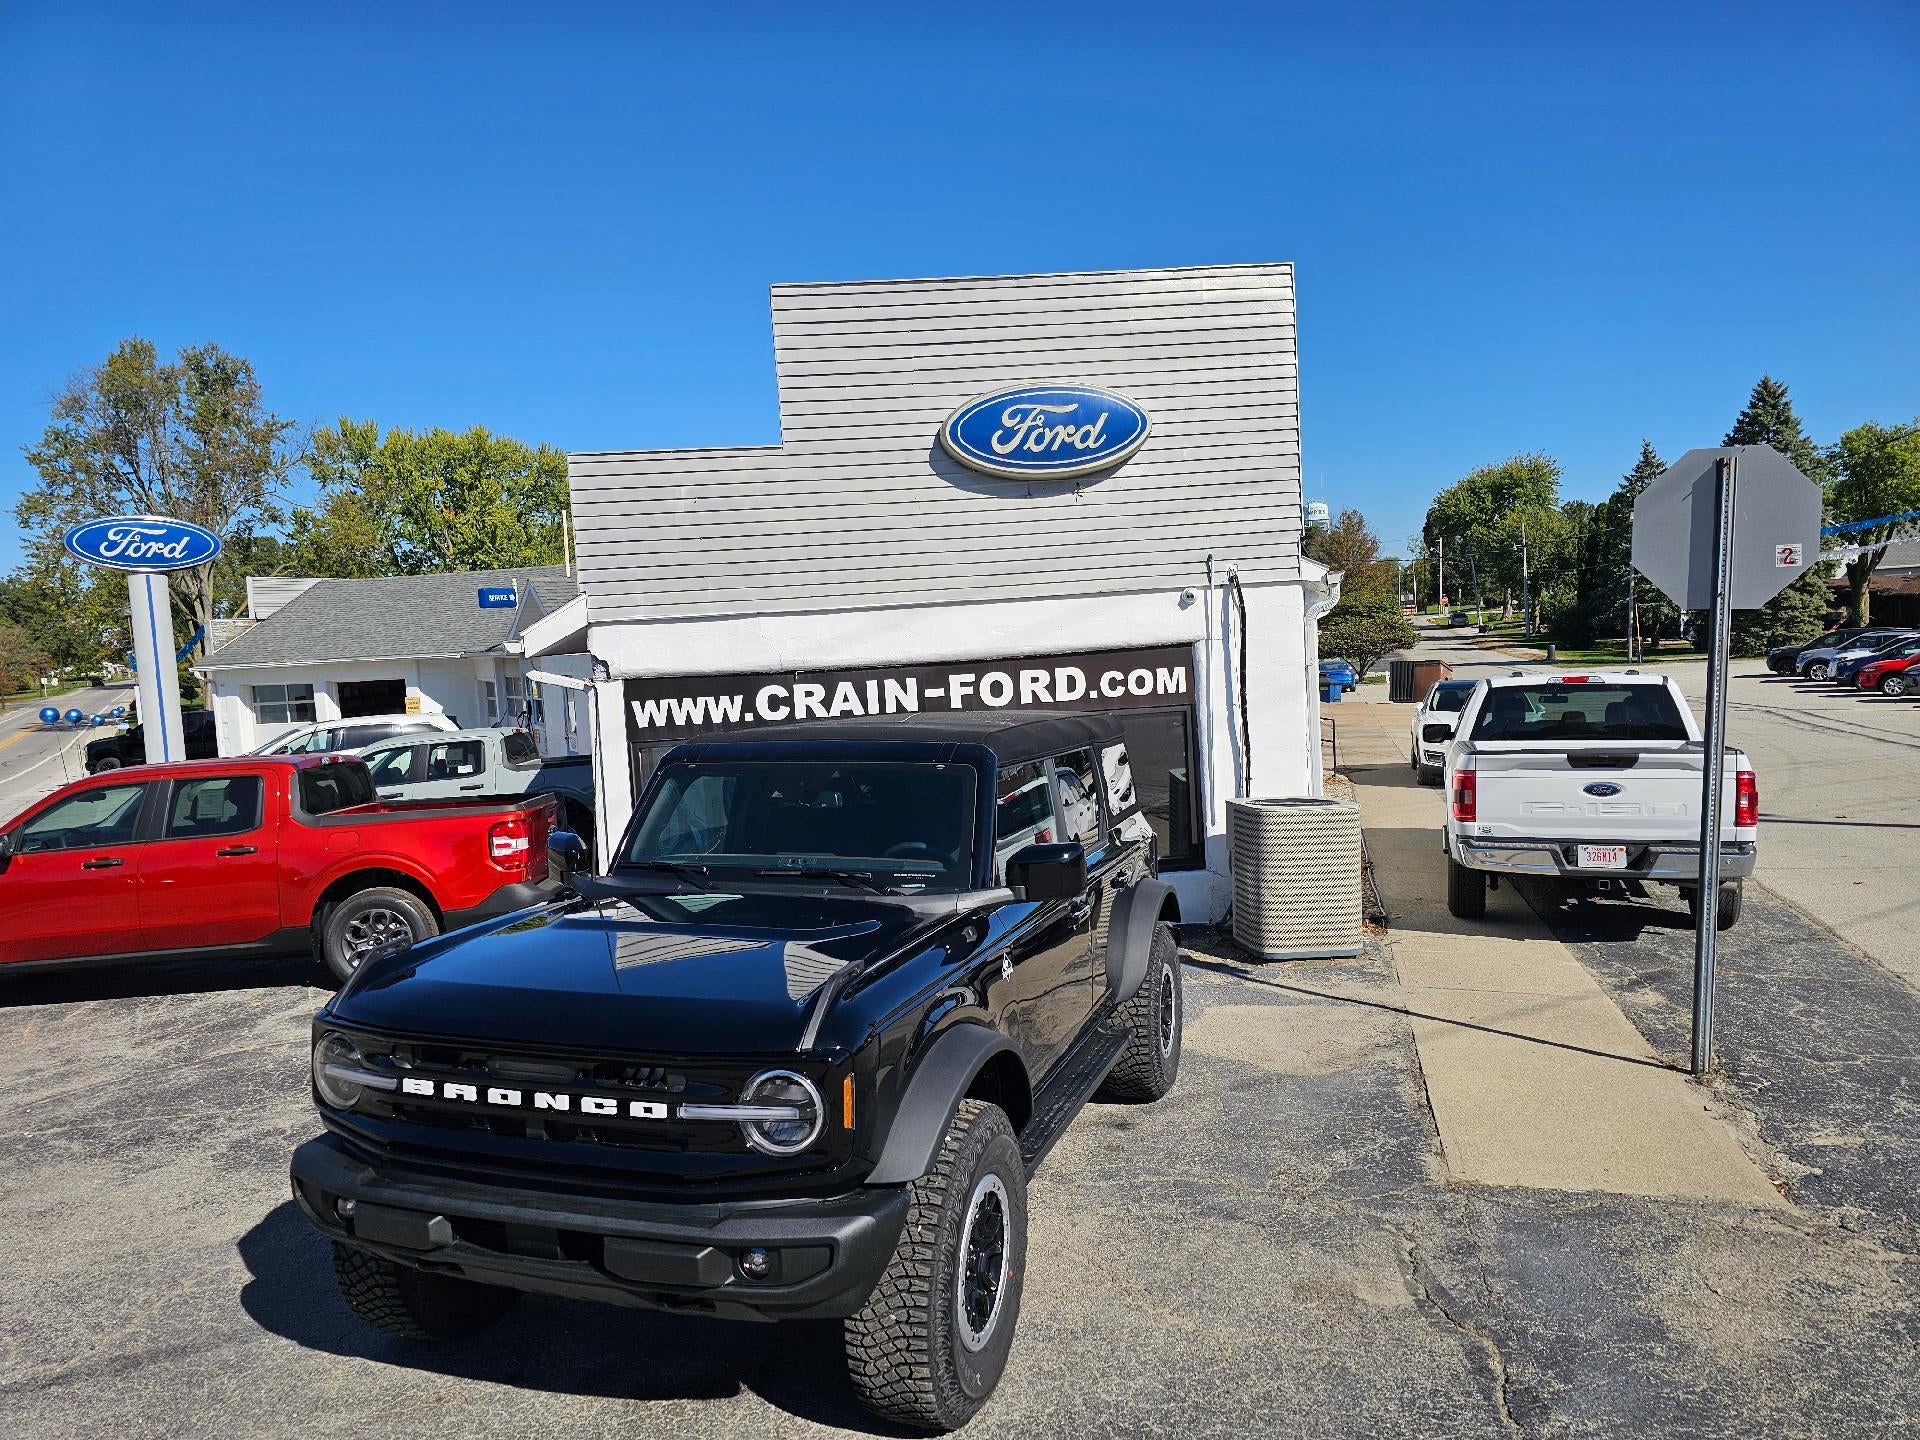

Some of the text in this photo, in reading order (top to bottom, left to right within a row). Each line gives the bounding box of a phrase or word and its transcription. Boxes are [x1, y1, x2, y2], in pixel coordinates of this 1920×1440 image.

[991, 403, 1109, 455] Ford
[99, 526, 191, 559] Ford
[1782, 547, 1795, 564] 2
[488, 594, 509, 602] SERVICE
[630, 666, 1187, 729] WWW.CRAIN-FORD.COM
[1591, 785, 1612, 795] Ford
[1519, 801, 1688, 817] F-150
[402, 1077, 668, 1119] BRONCO
